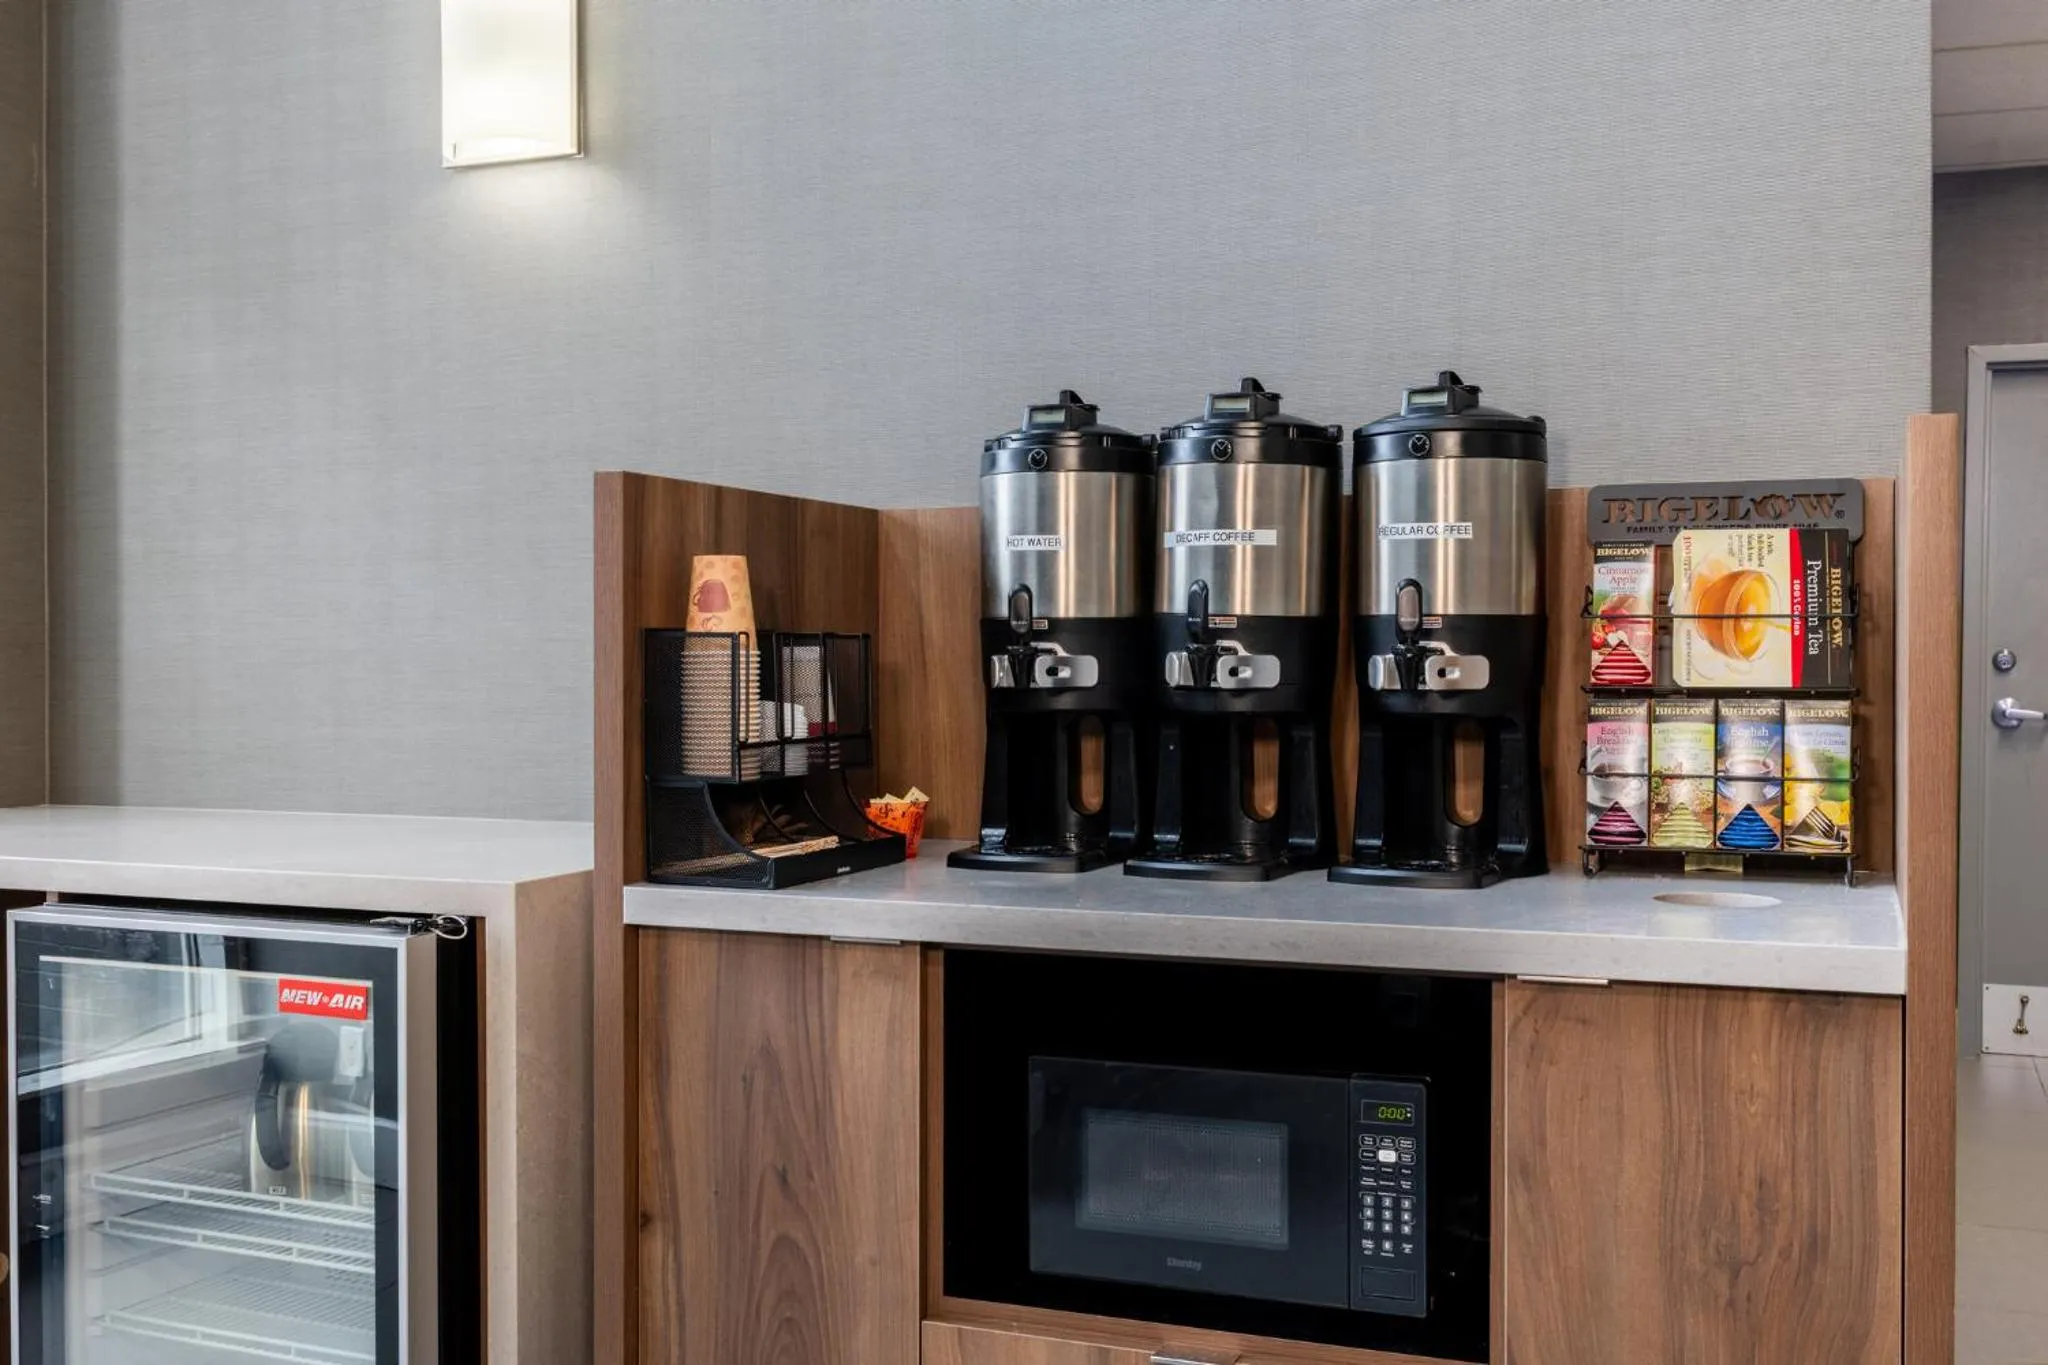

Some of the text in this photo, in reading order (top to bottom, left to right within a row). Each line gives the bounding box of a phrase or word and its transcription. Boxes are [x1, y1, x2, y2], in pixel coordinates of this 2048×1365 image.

[1377, 524, 1472, 536] REGULAR COFFEE
[1627, 525, 1664, 534] FAMILY
[1007, 536, 1062, 548] HOT WATER
[1176, 531, 1255, 543] DECAFF COFFEE
[1596, 547, 1650, 556] BIGELOW
[1609, 576, 1637, 587] Apple
[1806, 559, 1824, 655] Premium Tea
[1591, 706, 1646, 716] BIGELOW
[1655, 706, 1713, 716] BIGELOW
[1720, 707, 1780, 717] BIGELOW
